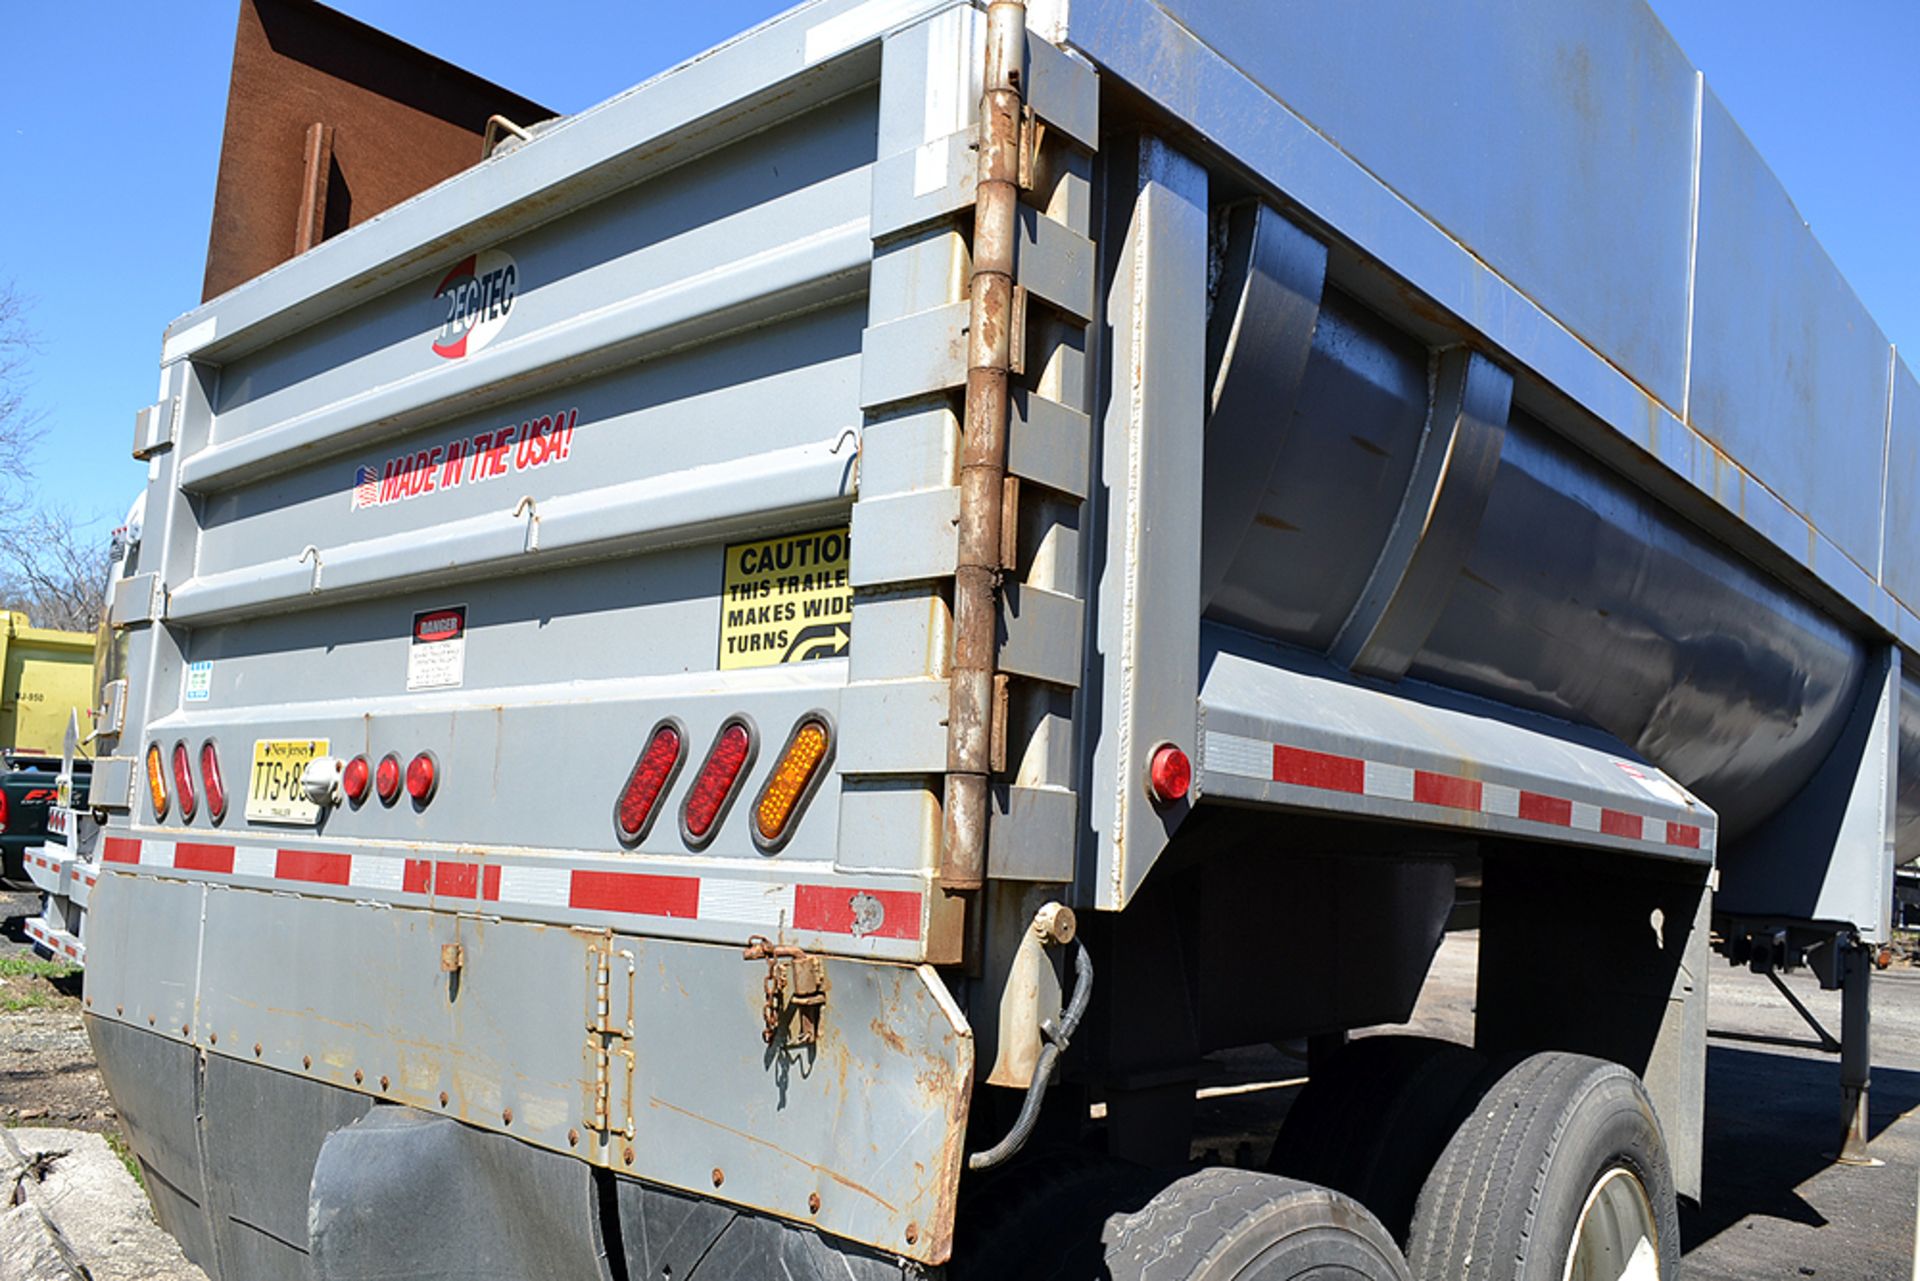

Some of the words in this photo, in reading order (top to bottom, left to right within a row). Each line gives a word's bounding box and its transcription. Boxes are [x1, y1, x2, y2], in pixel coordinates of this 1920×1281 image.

[380, 447, 443, 504] MADE
[441, 439, 469, 488] IN
[470, 428, 514, 480] THE
[516, 410, 577, 470] USA!
[729, 579, 771, 602] THIS
[776, 568, 850, 596] TRAILE
[727, 602, 796, 628] MAKES
[803, 595, 854, 618] WIDE
[727, 629, 789, 655] TURNS
